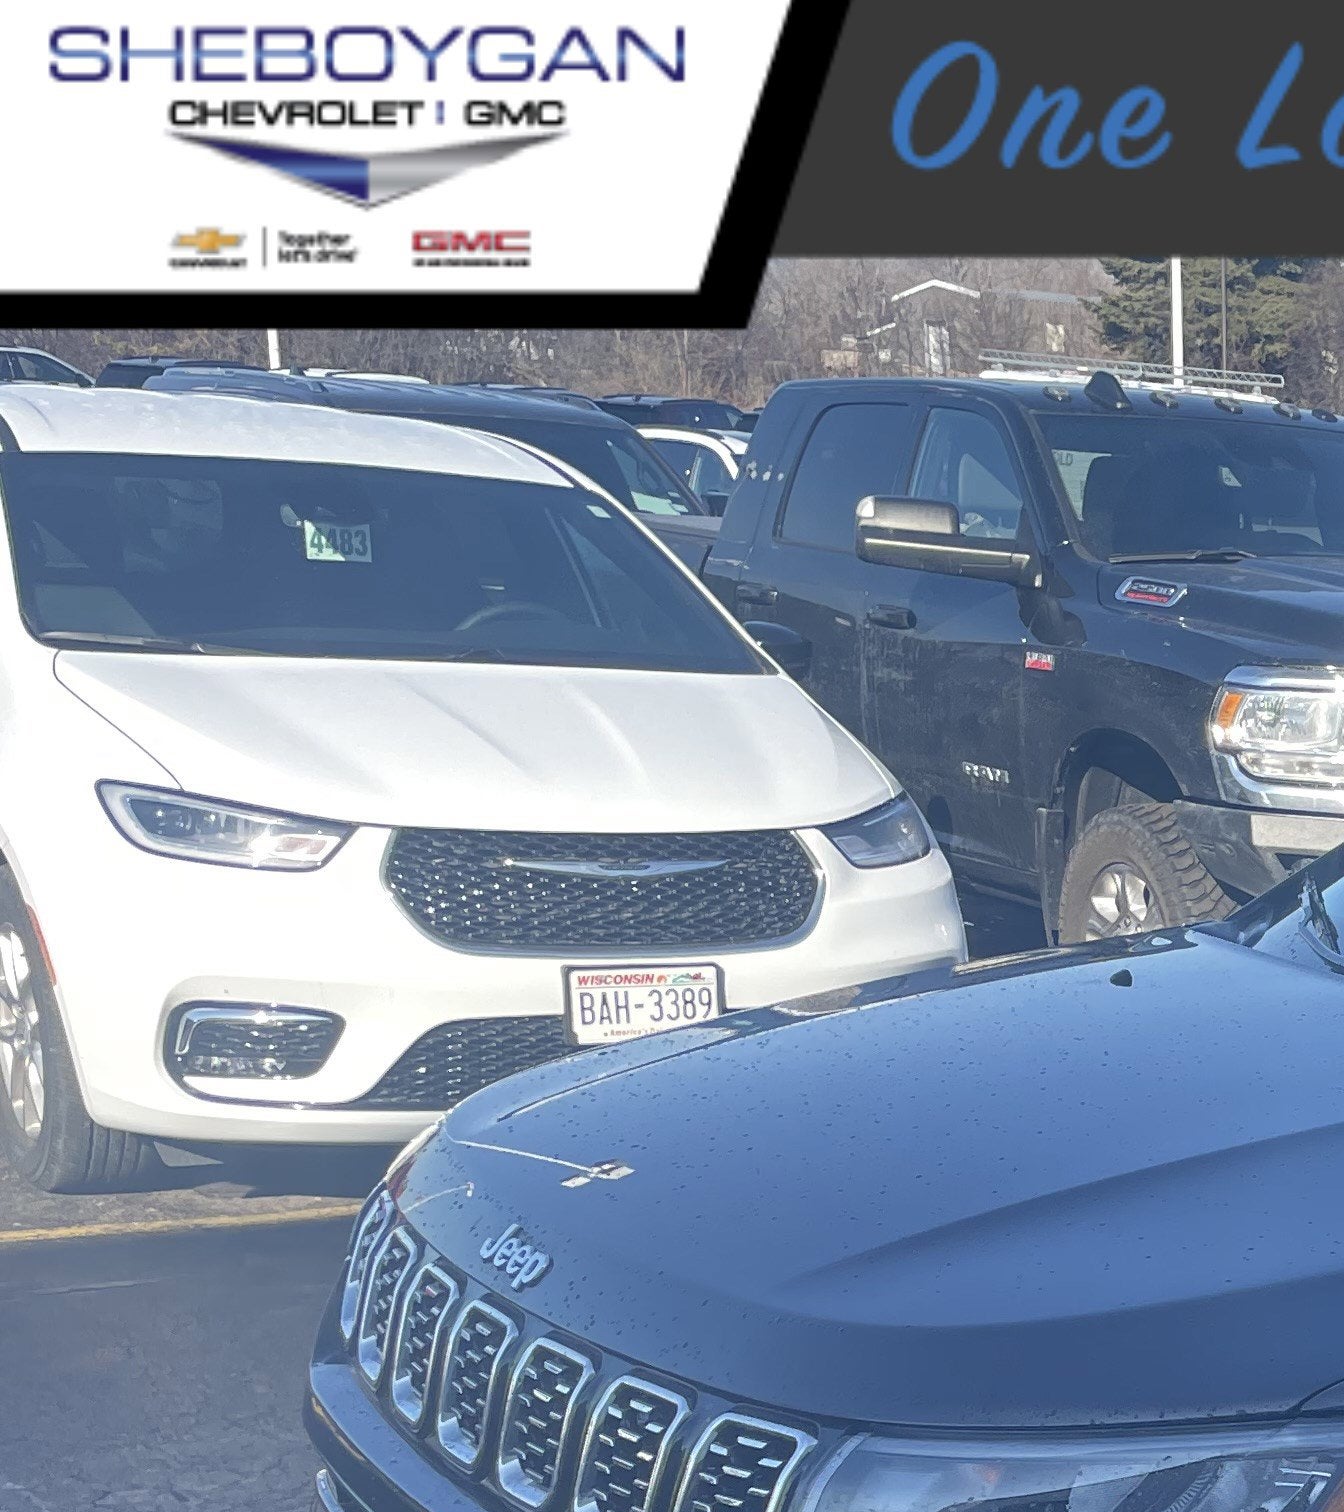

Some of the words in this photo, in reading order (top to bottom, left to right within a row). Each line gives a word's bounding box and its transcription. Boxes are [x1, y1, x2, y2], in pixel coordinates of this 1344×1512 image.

[577, 974, 655, 986] WISCONSIN
[579, 987, 713, 1026] BAH-3389
[480, 1223, 550, 1291] Jeep
